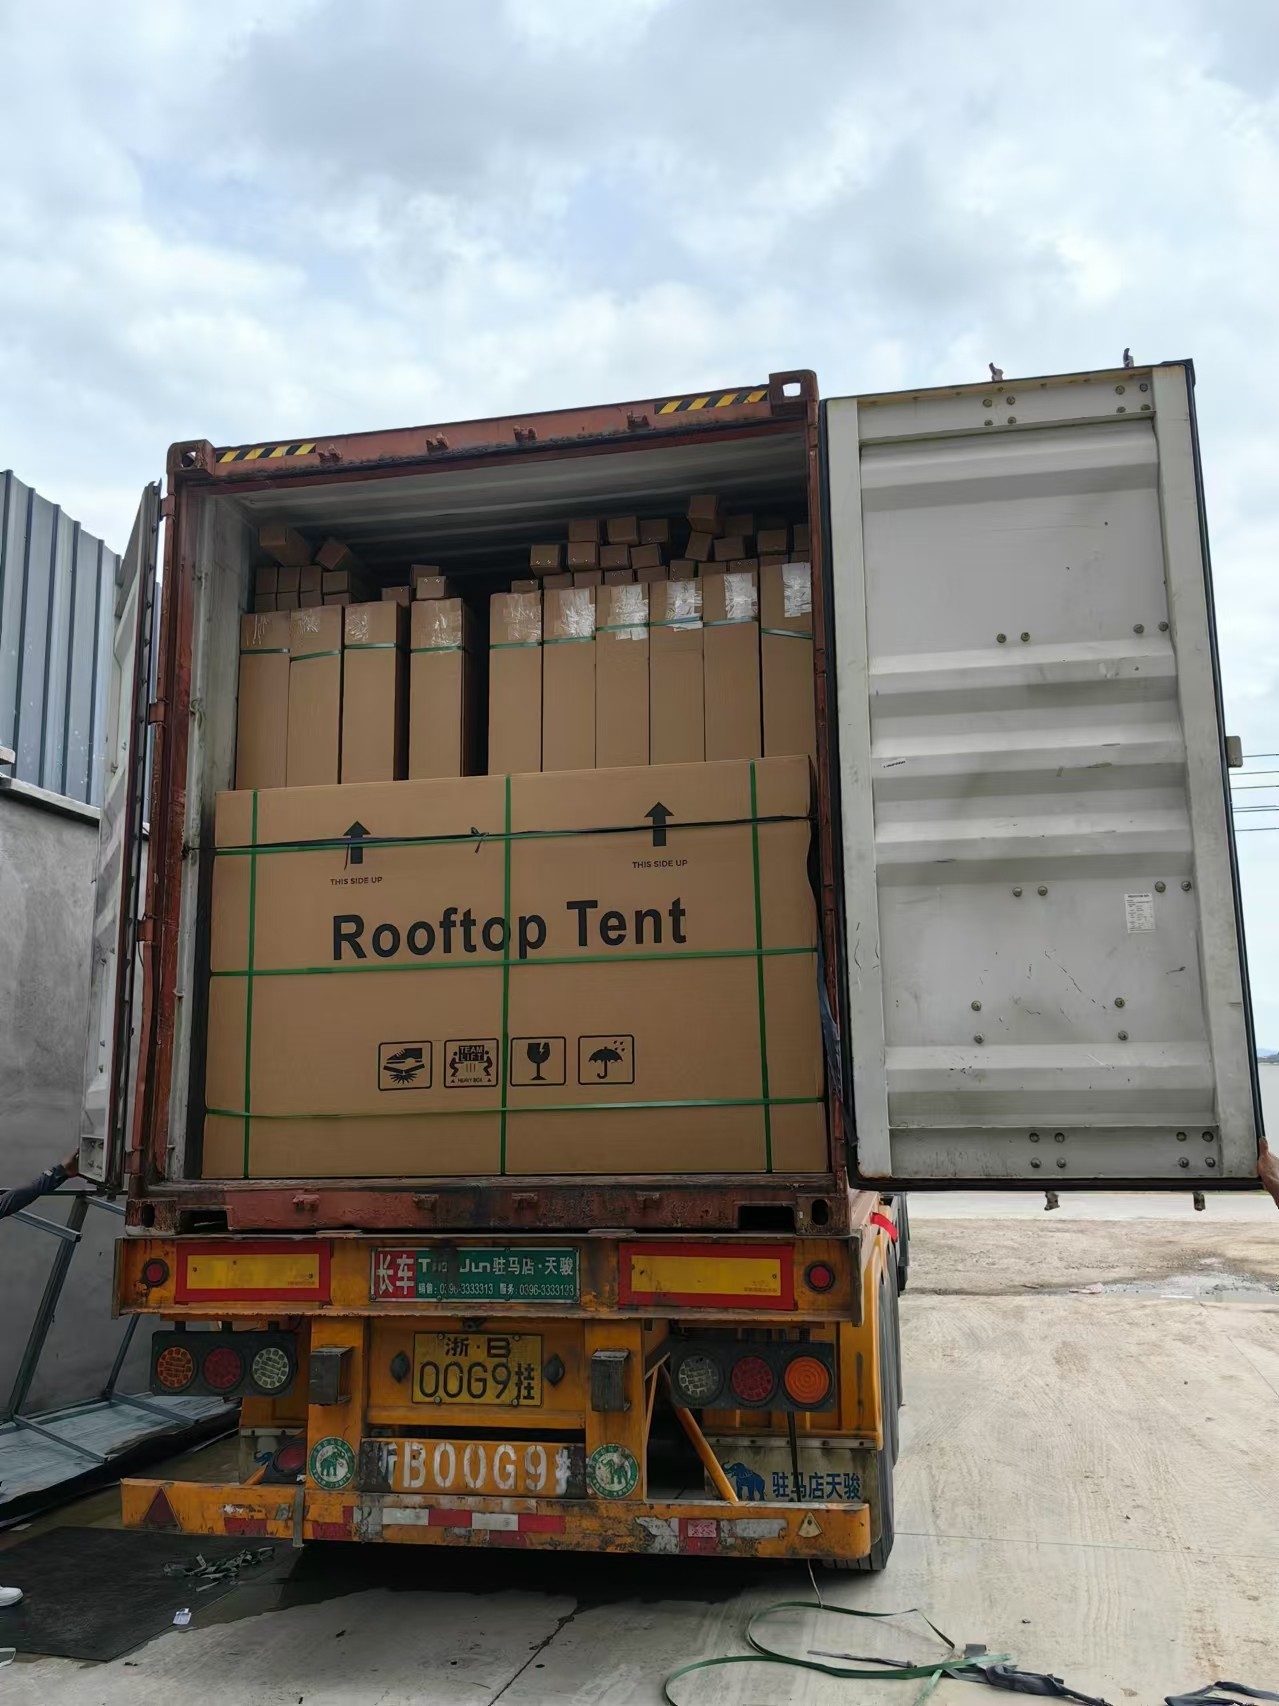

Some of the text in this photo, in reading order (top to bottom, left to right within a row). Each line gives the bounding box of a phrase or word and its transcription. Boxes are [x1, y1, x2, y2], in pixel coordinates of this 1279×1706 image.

[632, 859, 688, 869] THIS SIDE UP
[330, 876, 383, 886] THIS SIDE UP
[332, 897, 687, 961] Rooftop Tent
[460, 1046, 483, 1054] TEAM
[460, 1053, 482, 1061] LIFT
[772, 1471, 861, 1500] 驻马店天骏
